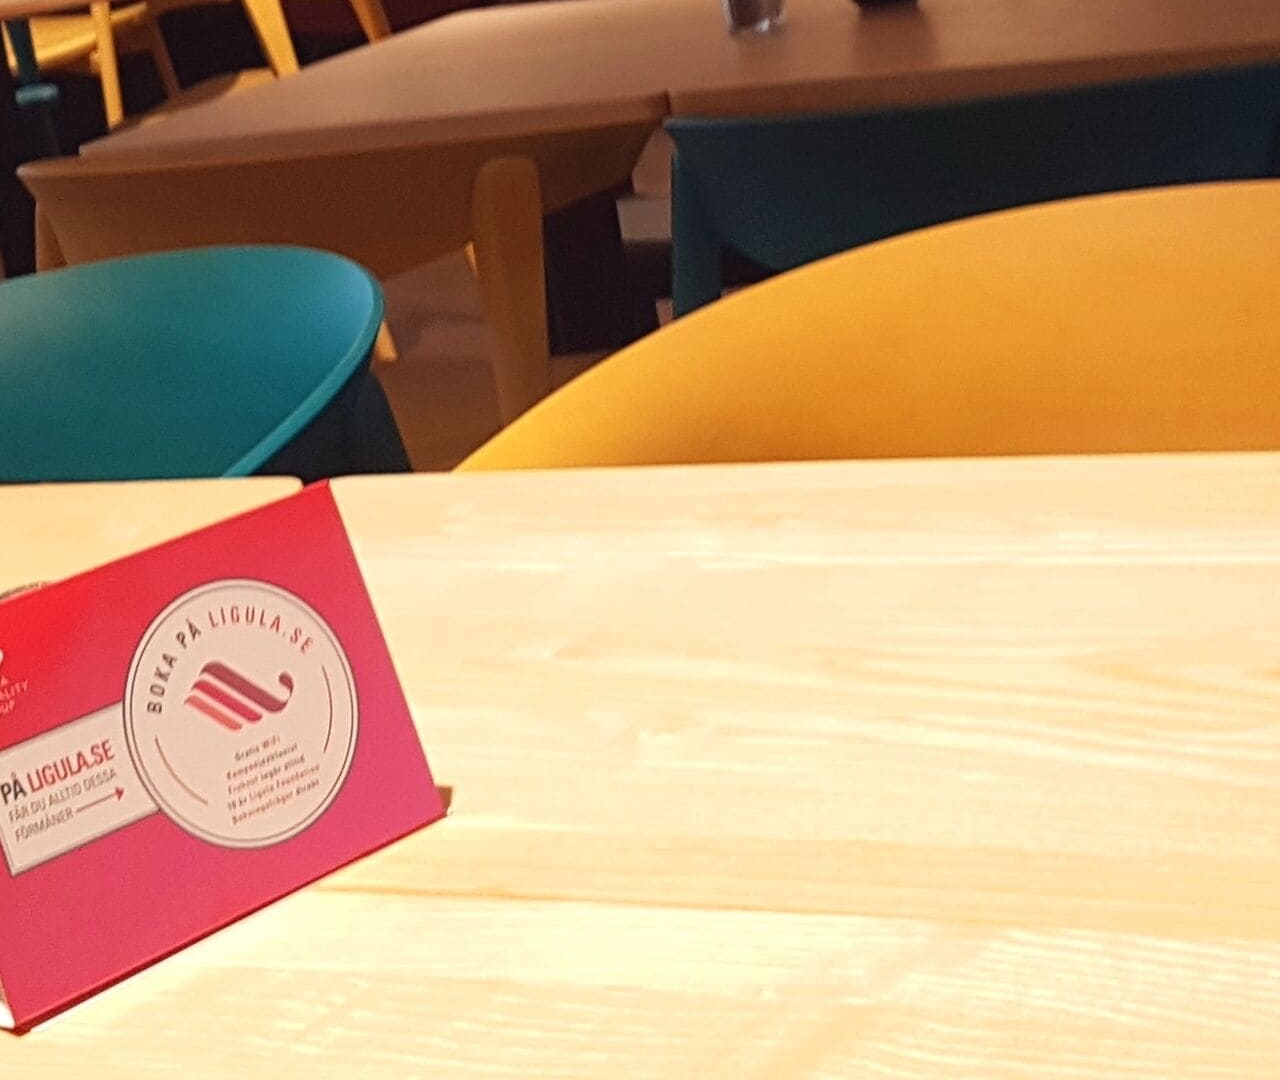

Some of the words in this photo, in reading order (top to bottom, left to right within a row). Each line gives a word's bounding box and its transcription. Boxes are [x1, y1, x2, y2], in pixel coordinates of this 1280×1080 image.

[147, 652, 178, 714] BOKA
[175, 617, 203, 651] PÅ
[208, 604, 314, 655] LIGULA.SE
[0, 771, 27, 806] PÅ
[26, 739, 116, 793] LIGULA.SE
[8, 806, 30, 823] FÅR
[30, 798, 47, 814] DU
[48, 784, 83, 809] ALLTID
[83, 768, 119, 792] DESSA
[14, 807, 75, 843] FÖRMÅNER
